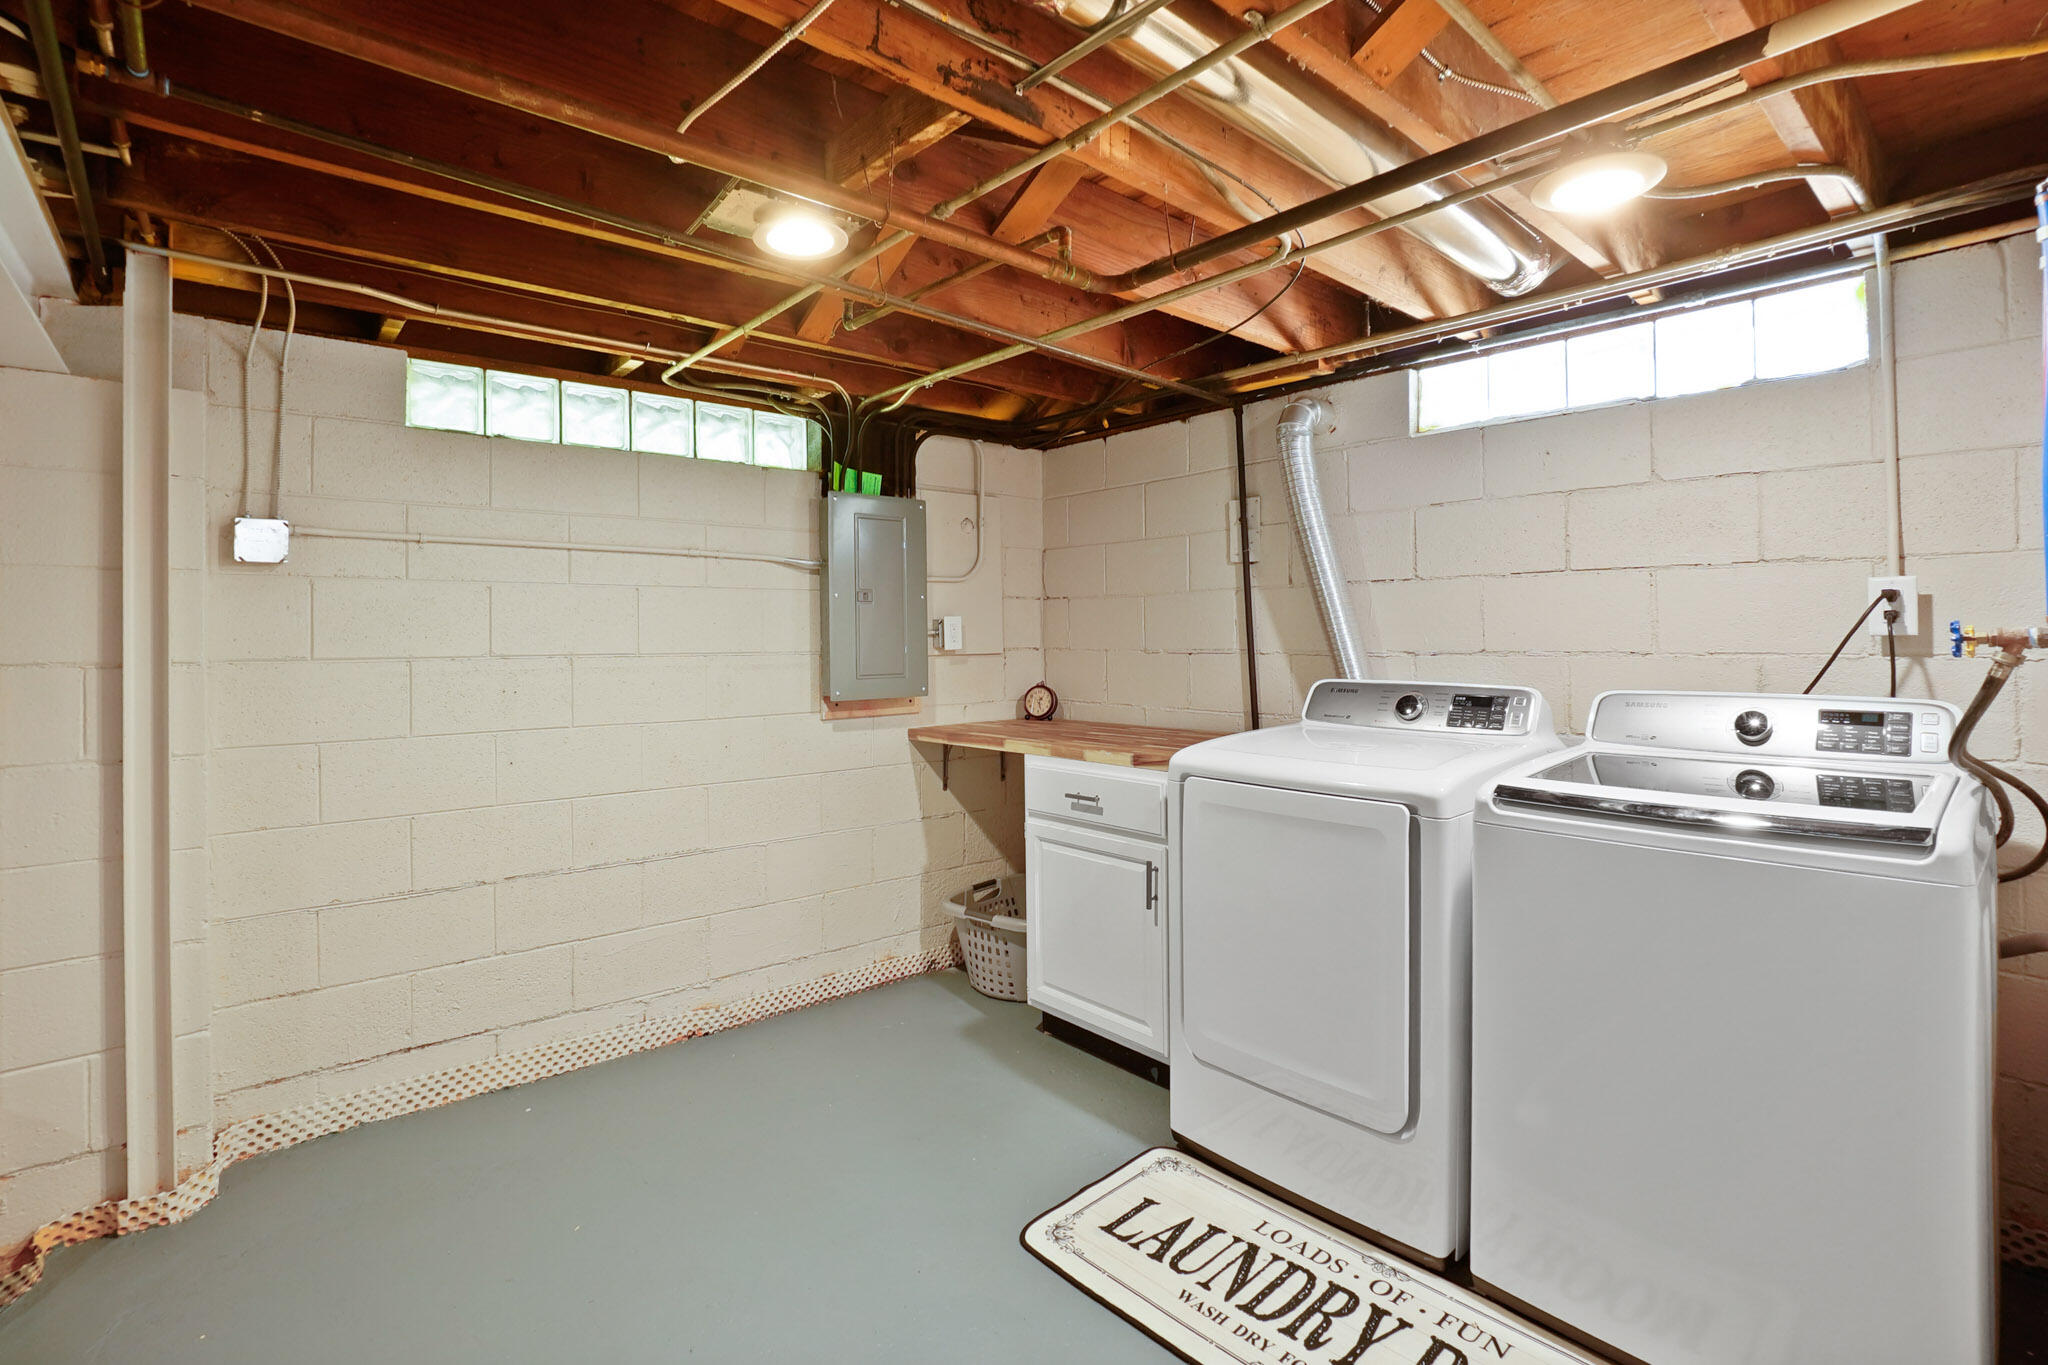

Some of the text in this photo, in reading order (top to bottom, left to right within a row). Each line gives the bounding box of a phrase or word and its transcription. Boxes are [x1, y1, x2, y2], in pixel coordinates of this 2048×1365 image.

[1098, 1197, 1414, 1365] LAUNDRY
[1178, 1288, 1230, 1326] WASH
[1232, 1324, 1276, 1352] DRY
[1252, 1220, 1350, 1274] LOADS
[1369, 1279, 1414, 1306] OF
[1433, 1311, 1515, 1360] FUN
